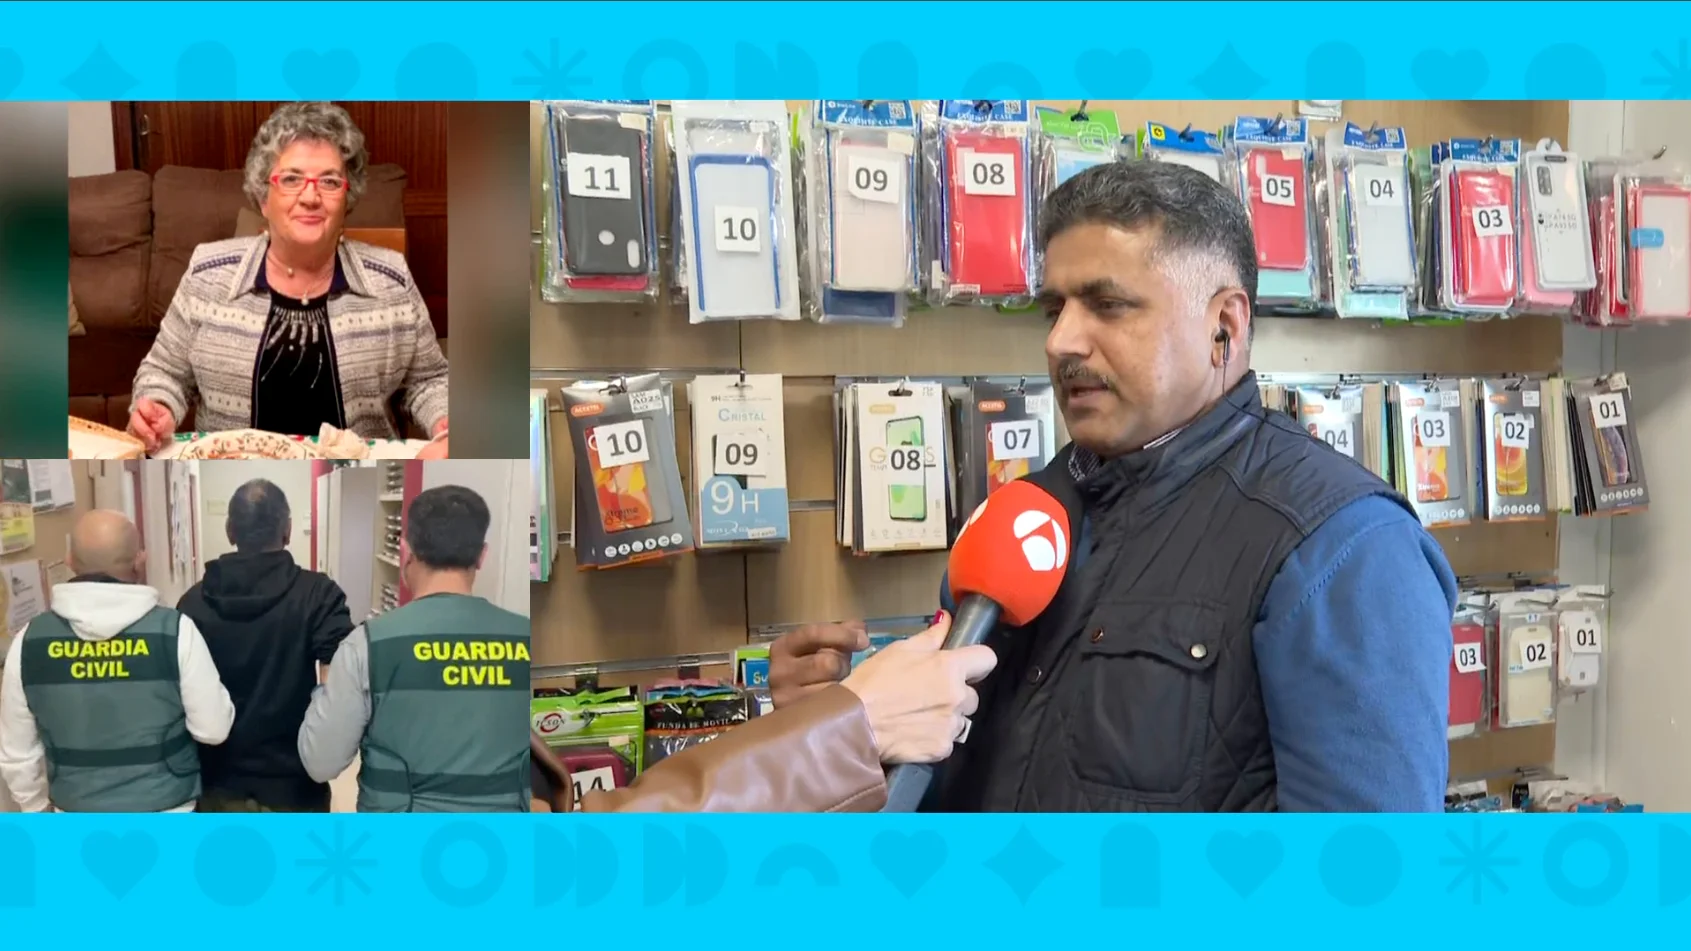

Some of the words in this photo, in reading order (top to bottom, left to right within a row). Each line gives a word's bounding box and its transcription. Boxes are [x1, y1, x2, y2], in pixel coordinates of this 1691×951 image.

[584, 166, 620, 192] 11
[855, 167, 889, 192] 09
[972, 162, 1006, 185] 08
[1265, 178, 1291, 198] 05
[1369, 179, 1394, 198] 04
[1478, 210, 1504, 228] 03
[722, 217, 757, 241] 10
[718, 408, 767, 422] CRISTAL
[1599, 400, 1621, 419] 01
[1423, 419, 1445, 438] 03
[1505, 421, 1525, 440] 02
[606, 429, 643, 458] 10
[1003, 428, 1032, 450] 07
[1324, 429, 1349, 448] 04
[725, 443, 759, 466] 09
[890, 449, 921, 471] 08
[1576, 629, 1597, 646] 01
[48, 639, 149, 658] GUARDIA
[413, 641, 530, 661] GUARDIA
[1459, 648, 1477, 667] 03
[1526, 643, 1547, 662] 02
[70, 660, 130, 679] CIVIL
[442, 665, 511, 686] CIVIL
[657, 721, 687, 729] FUNDA
